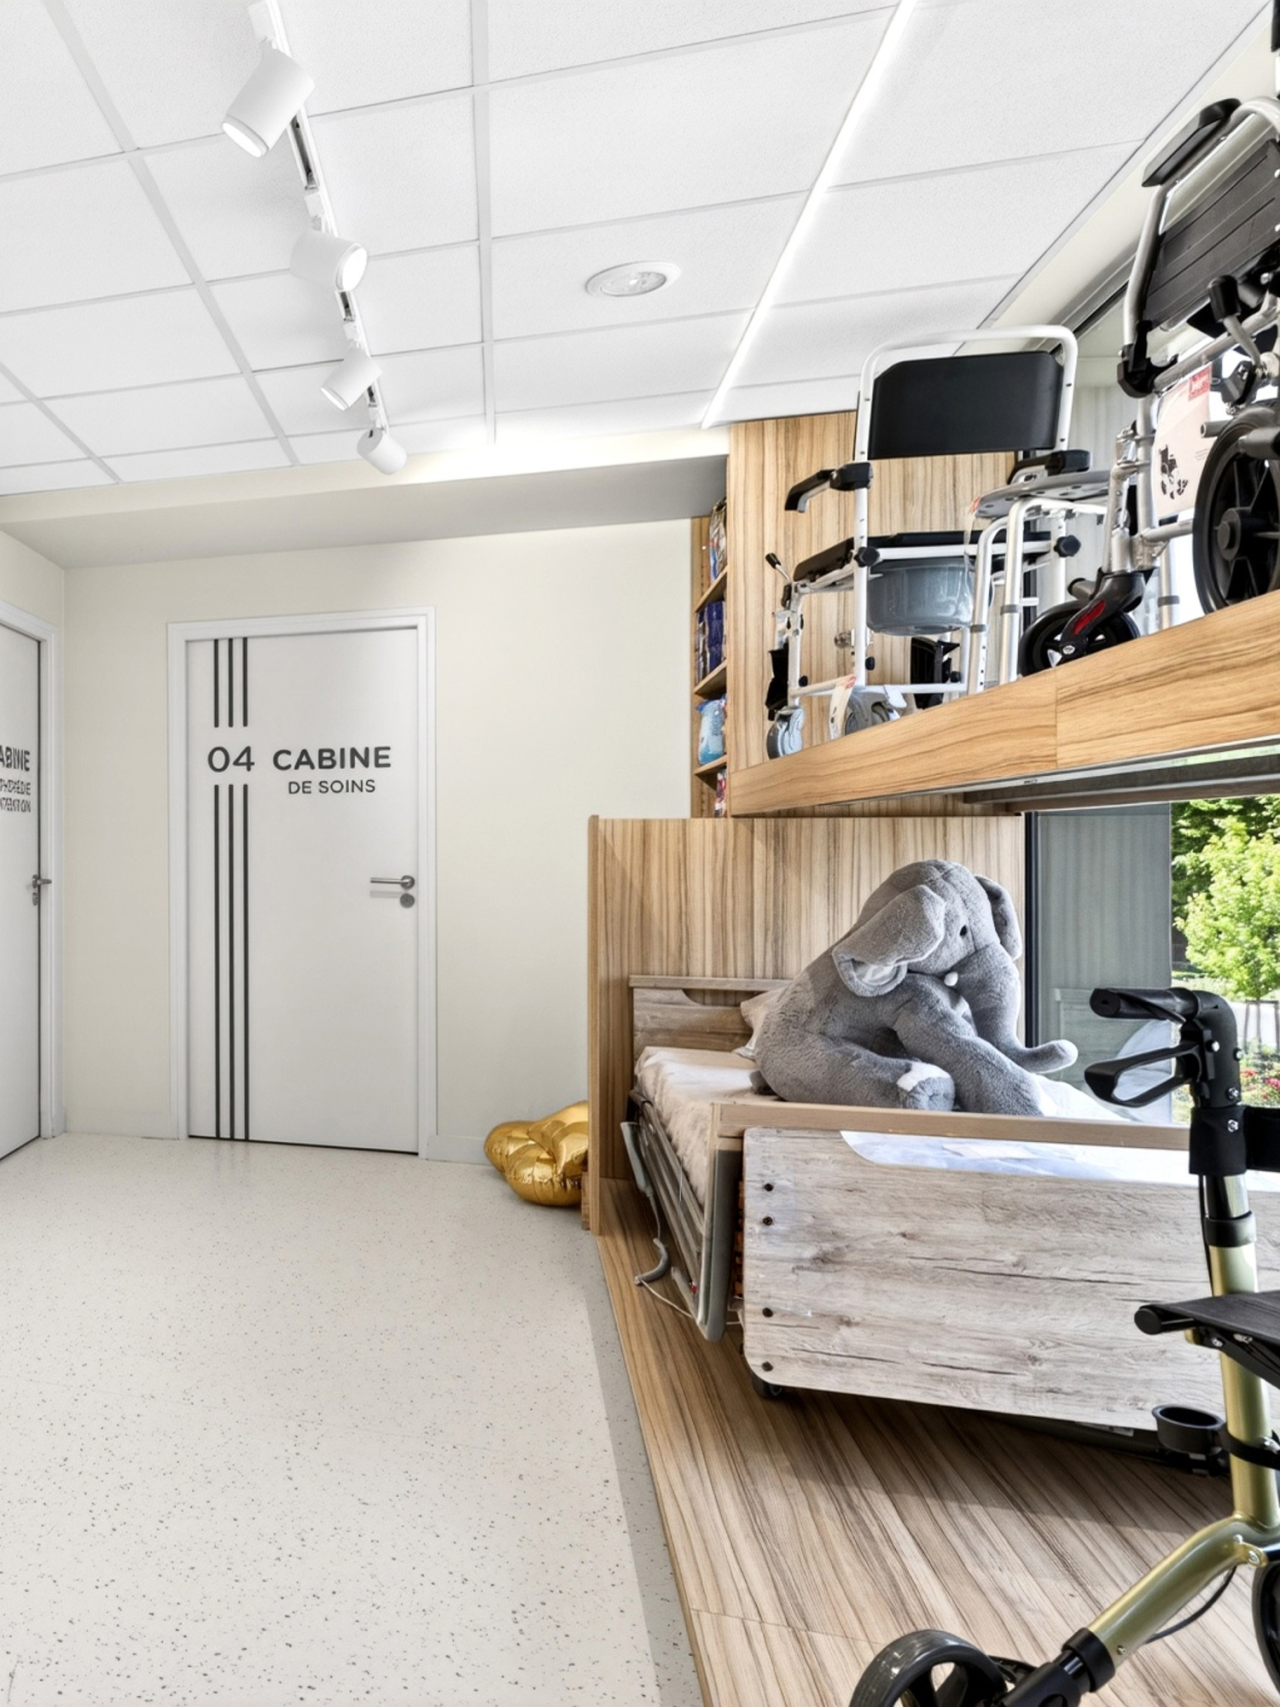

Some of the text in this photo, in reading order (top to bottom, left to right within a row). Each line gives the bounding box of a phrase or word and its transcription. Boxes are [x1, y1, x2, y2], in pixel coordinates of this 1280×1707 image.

[207, 745, 391, 772] 04 CABINE
[288, 779, 376, 794] DE SOINS
